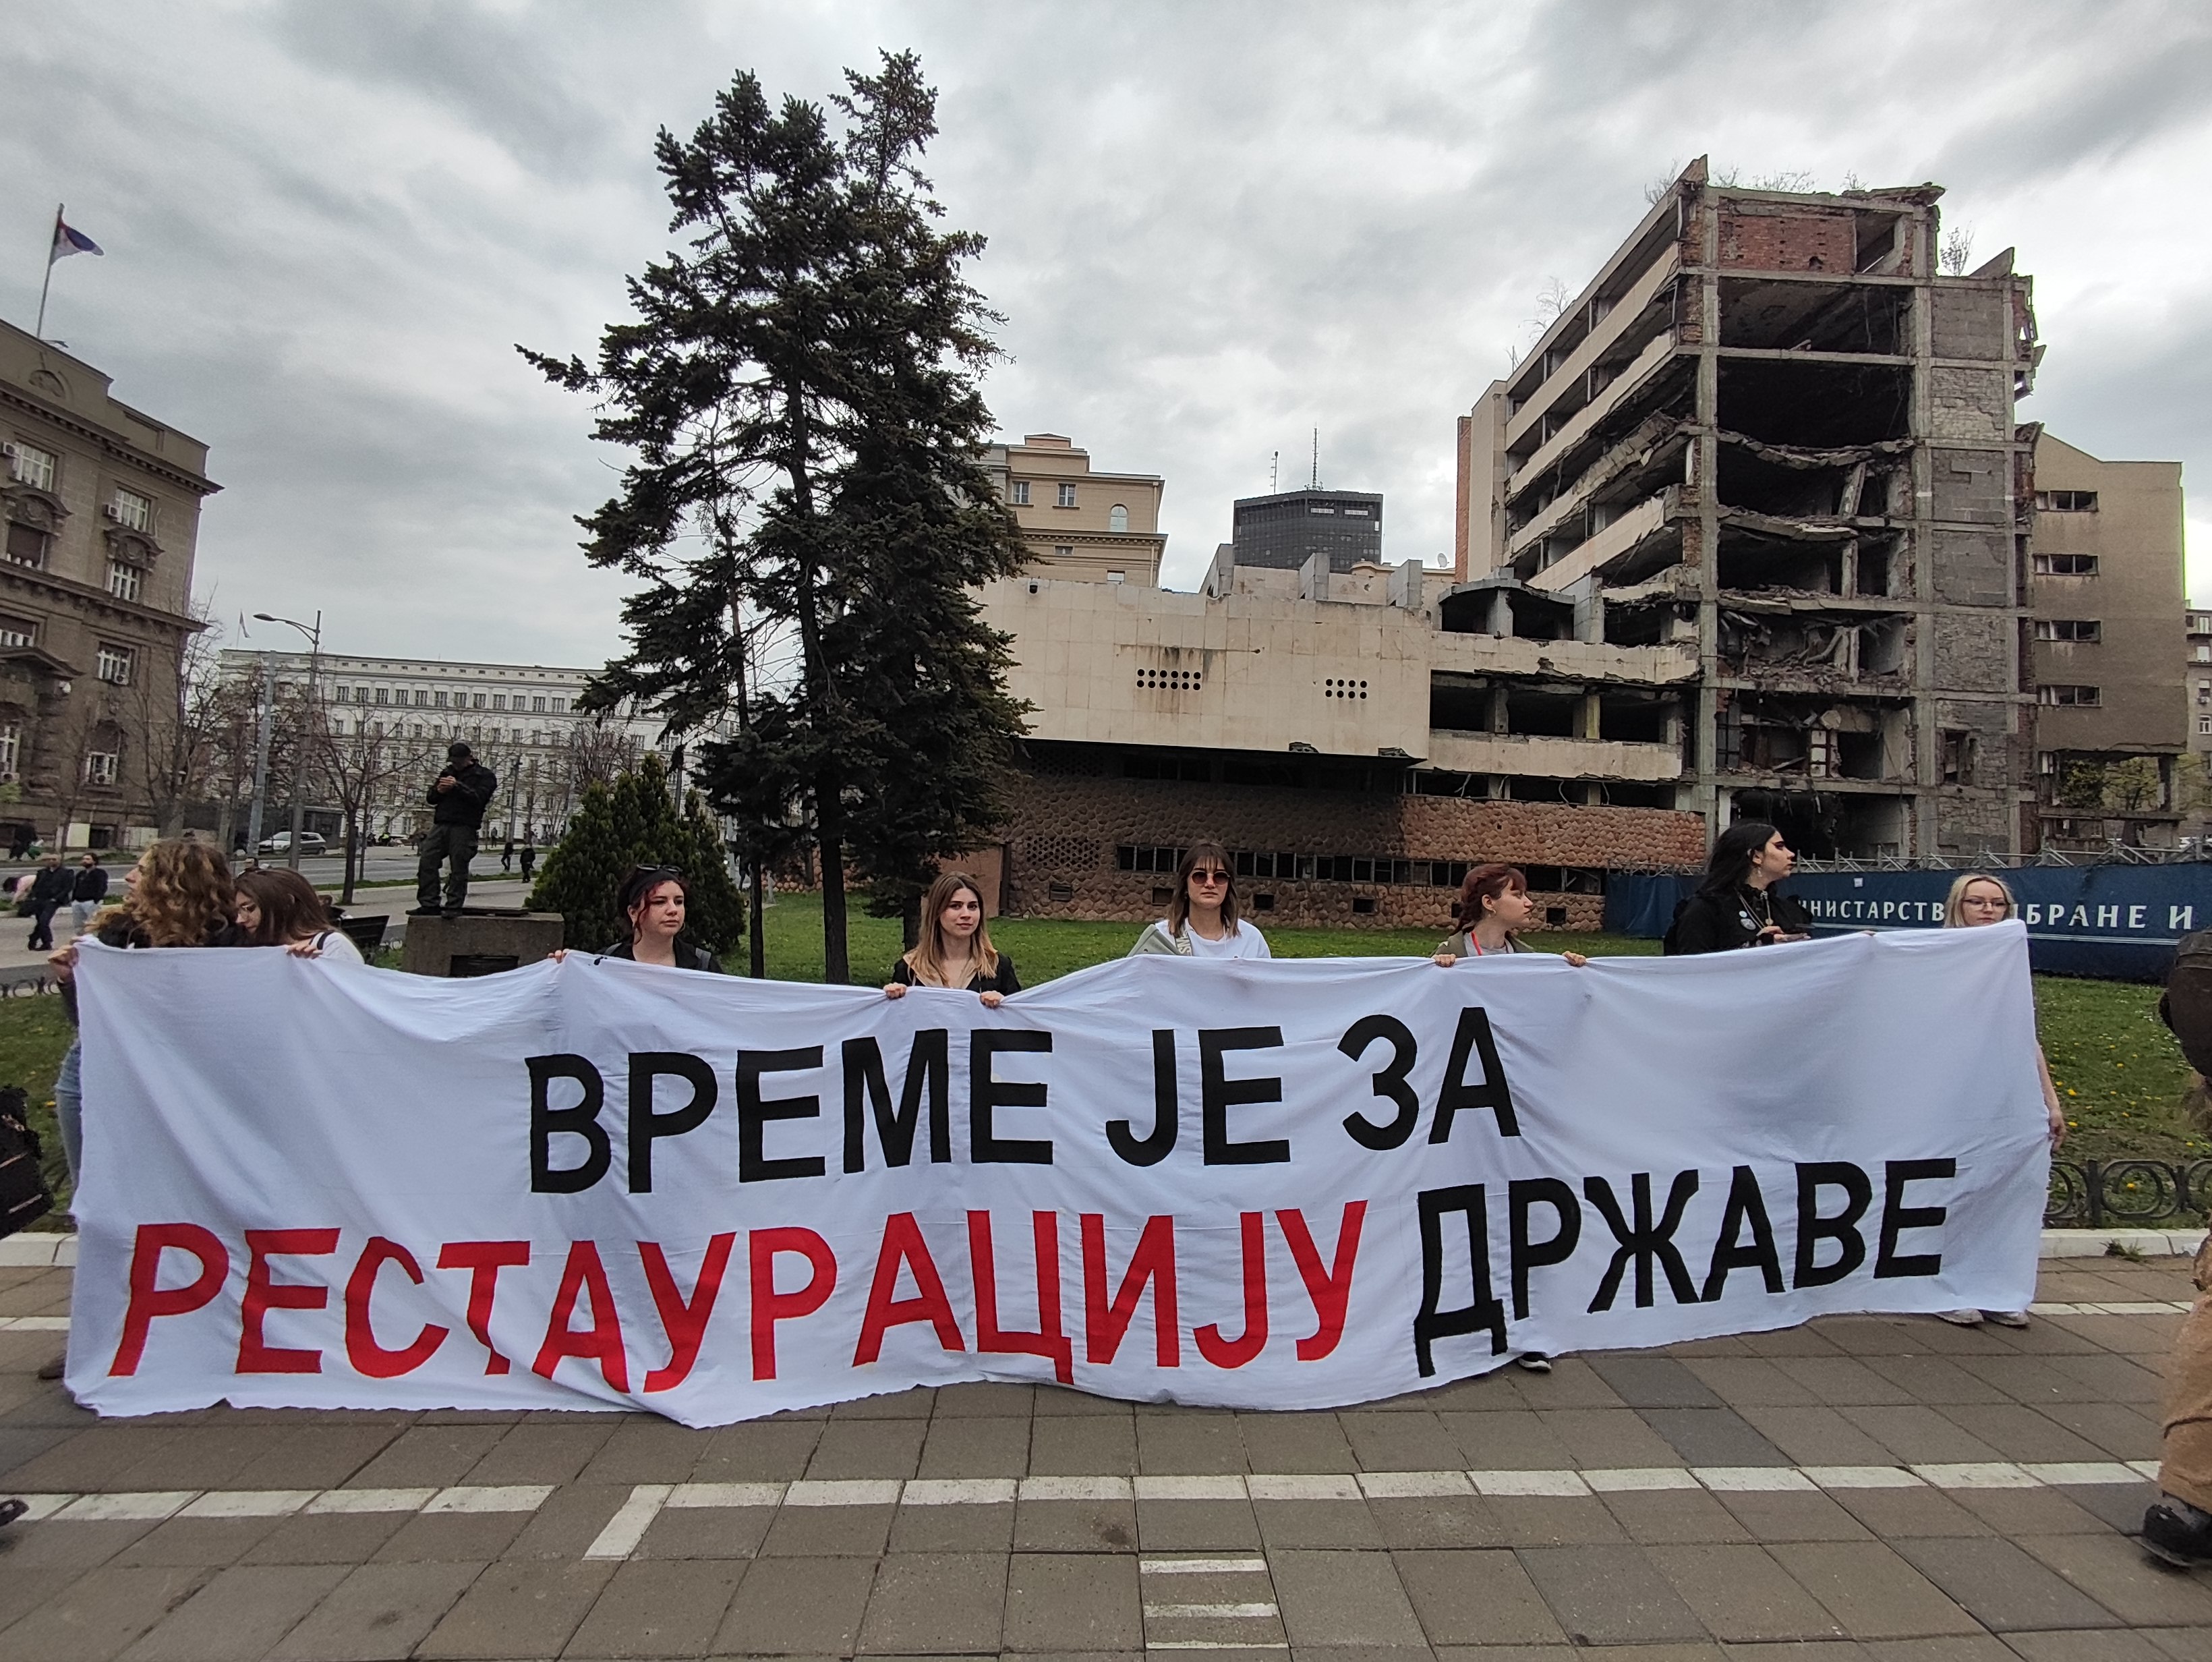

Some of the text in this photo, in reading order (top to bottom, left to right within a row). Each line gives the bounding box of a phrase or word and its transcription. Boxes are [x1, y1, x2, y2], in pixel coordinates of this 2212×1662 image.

[2168, 905, 2193, 930] И
[525, 1006, 1521, 1193] ВРЕМЕ ЈЕ ЗА
[109, 1157, 1956, 1394] РЕСТАУРАЦИЈУ ДРЖАВЕ
